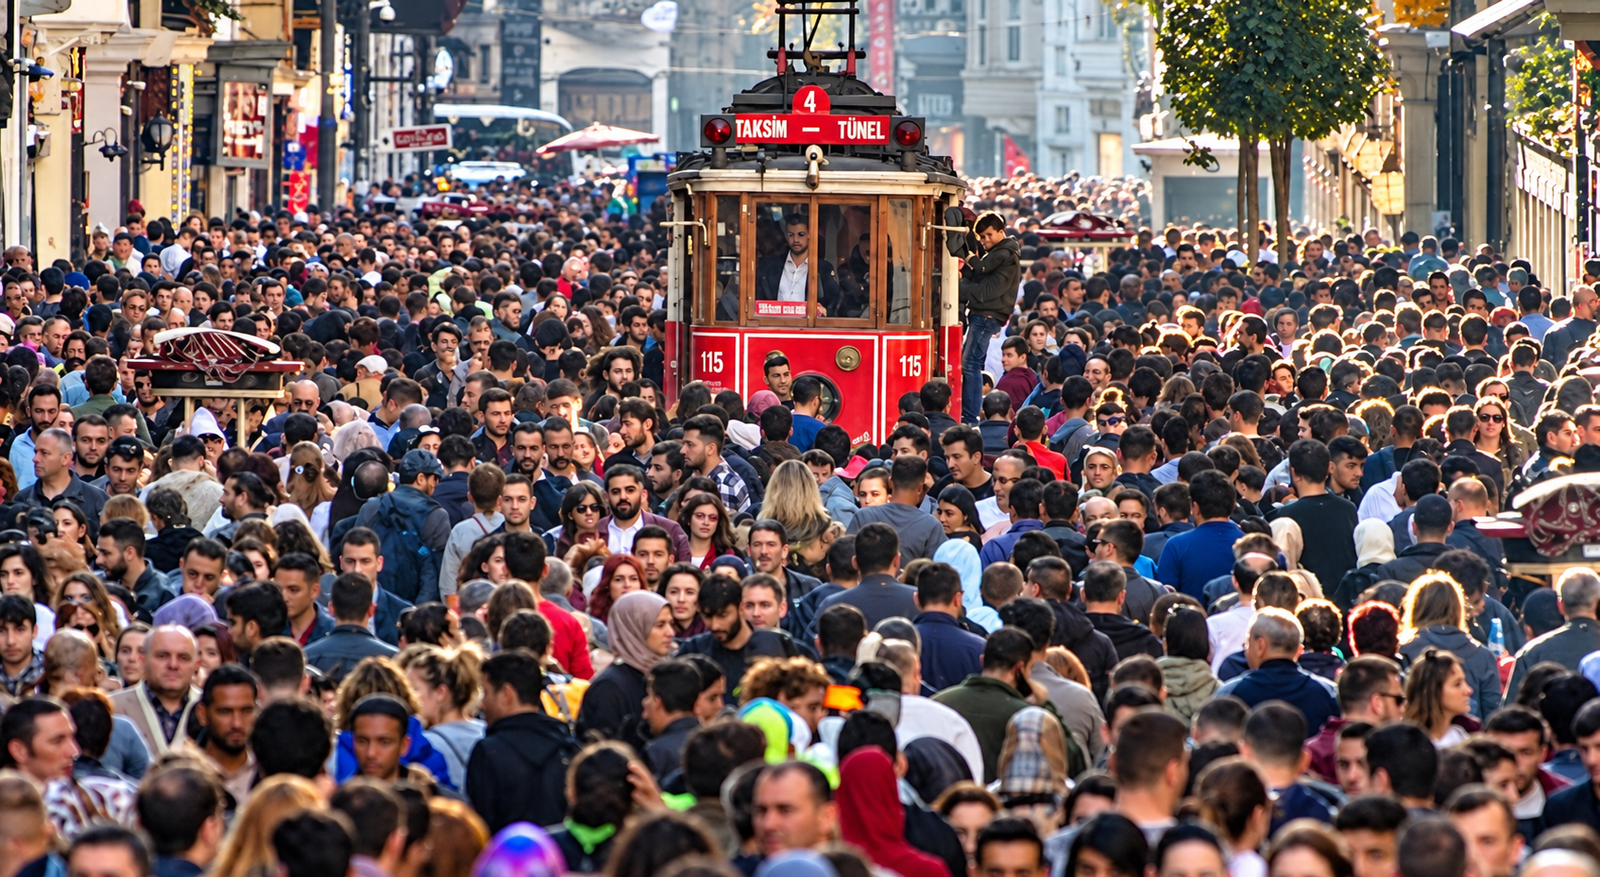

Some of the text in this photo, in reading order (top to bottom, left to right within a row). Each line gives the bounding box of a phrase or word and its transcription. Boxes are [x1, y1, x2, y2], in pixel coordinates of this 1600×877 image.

[803, 91, 817, 113] 4
[736, 115, 788, 139] TAKSİM
[838, 116, 886, 140] TÜNEL
[701, 351, 724, 373] 115
[899, 355, 922, 377] 115
